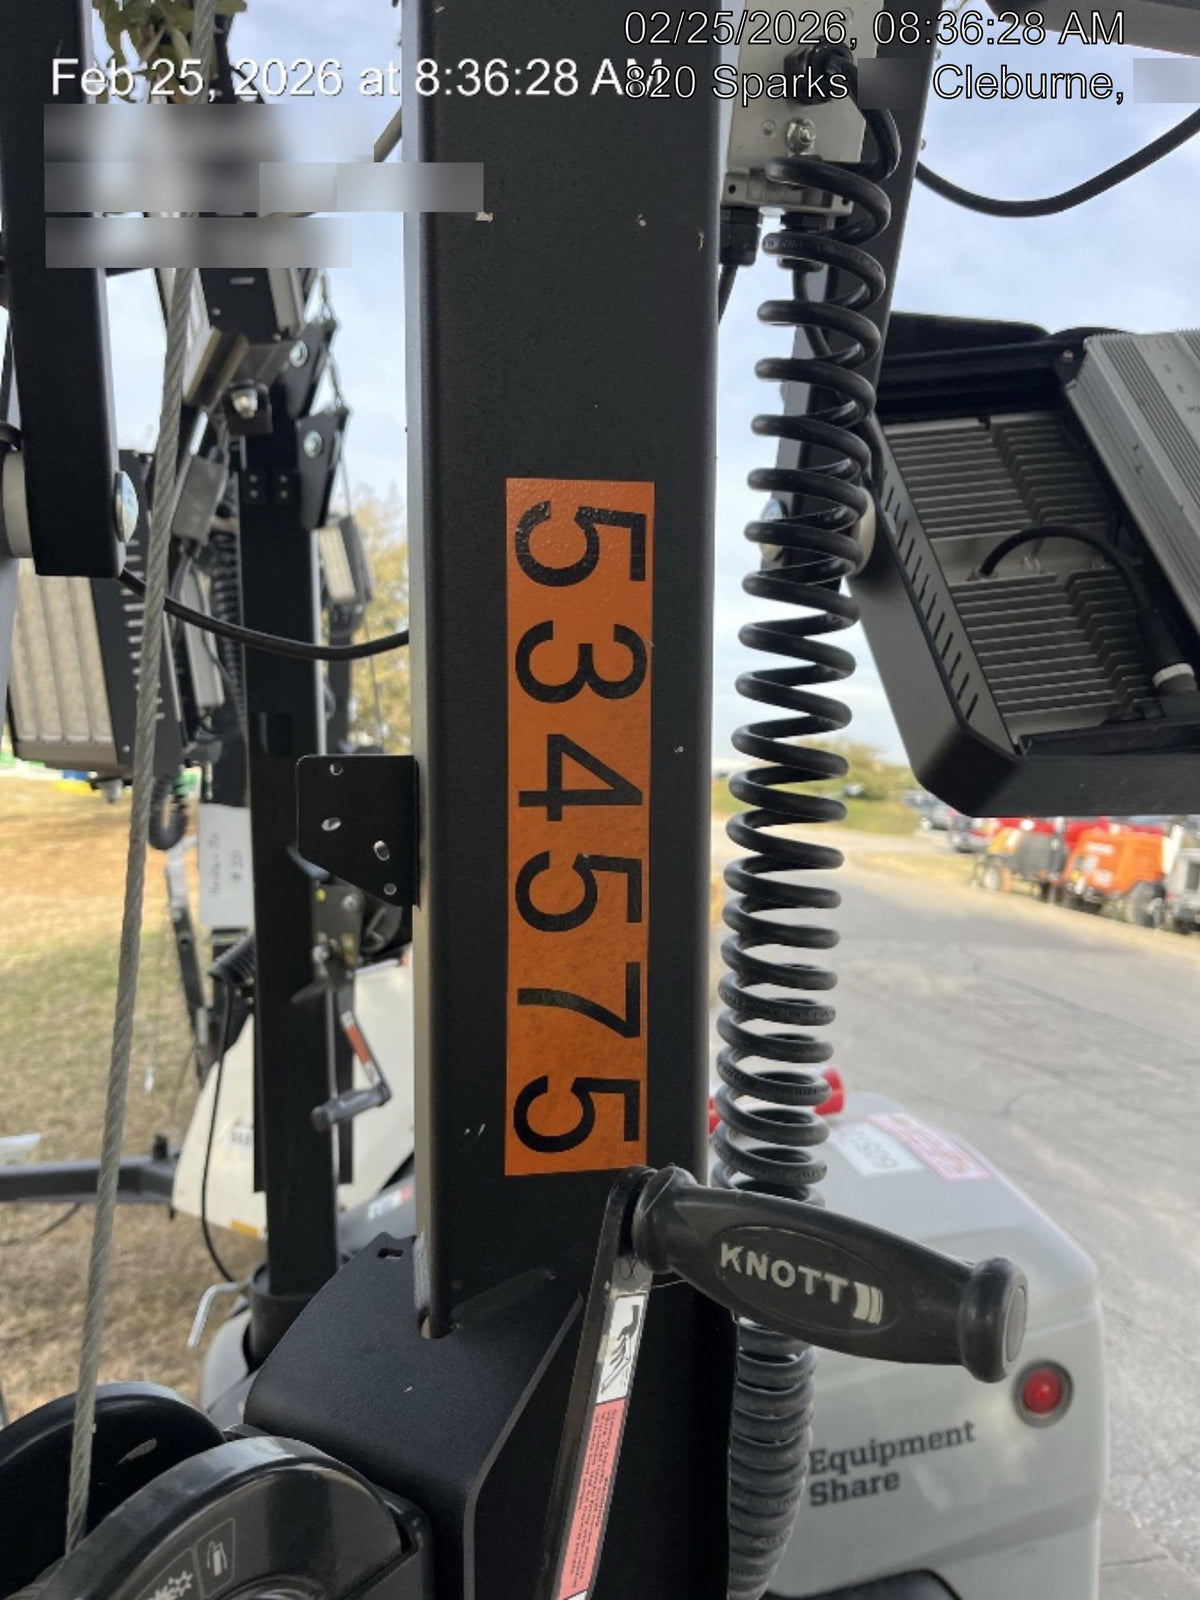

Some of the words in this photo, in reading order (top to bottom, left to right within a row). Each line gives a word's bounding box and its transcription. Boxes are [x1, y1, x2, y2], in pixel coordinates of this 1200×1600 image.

[513, 499, 649, 1153] 534575
[720, 1242, 849, 1304] KNOTT
[809, 1420, 977, 1476] Equipment
[809, 1471, 901, 1507] Share
